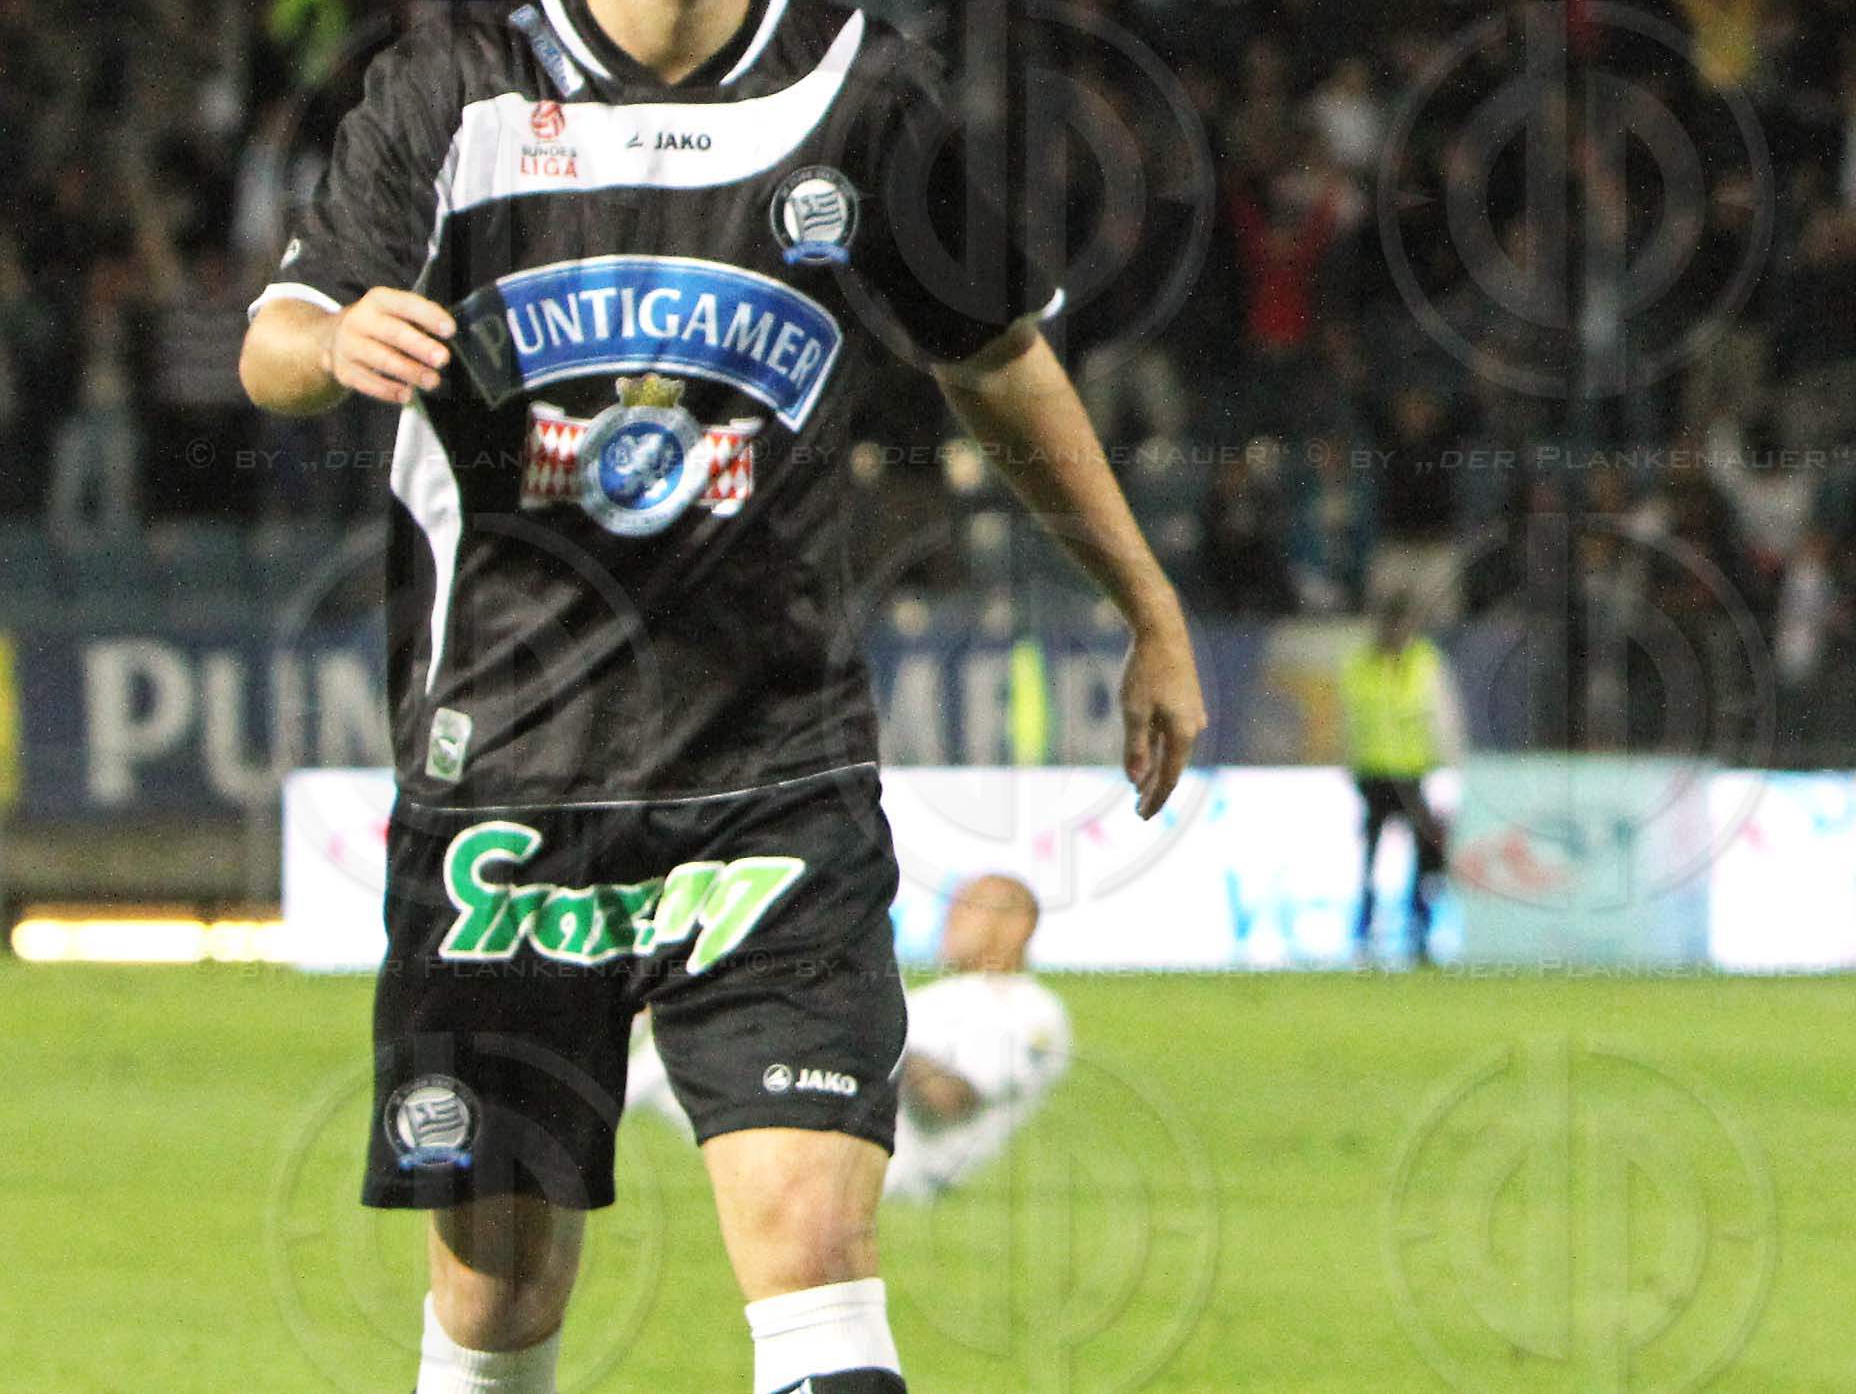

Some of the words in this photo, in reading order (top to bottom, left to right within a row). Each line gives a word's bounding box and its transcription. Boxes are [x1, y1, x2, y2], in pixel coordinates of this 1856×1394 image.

[653, 131, 712, 151] JAKO
[519, 156, 578, 178] LIGA
[468, 286, 822, 388] PUNTIGAMER
[796, 1067, 858, 1096] JAKO
